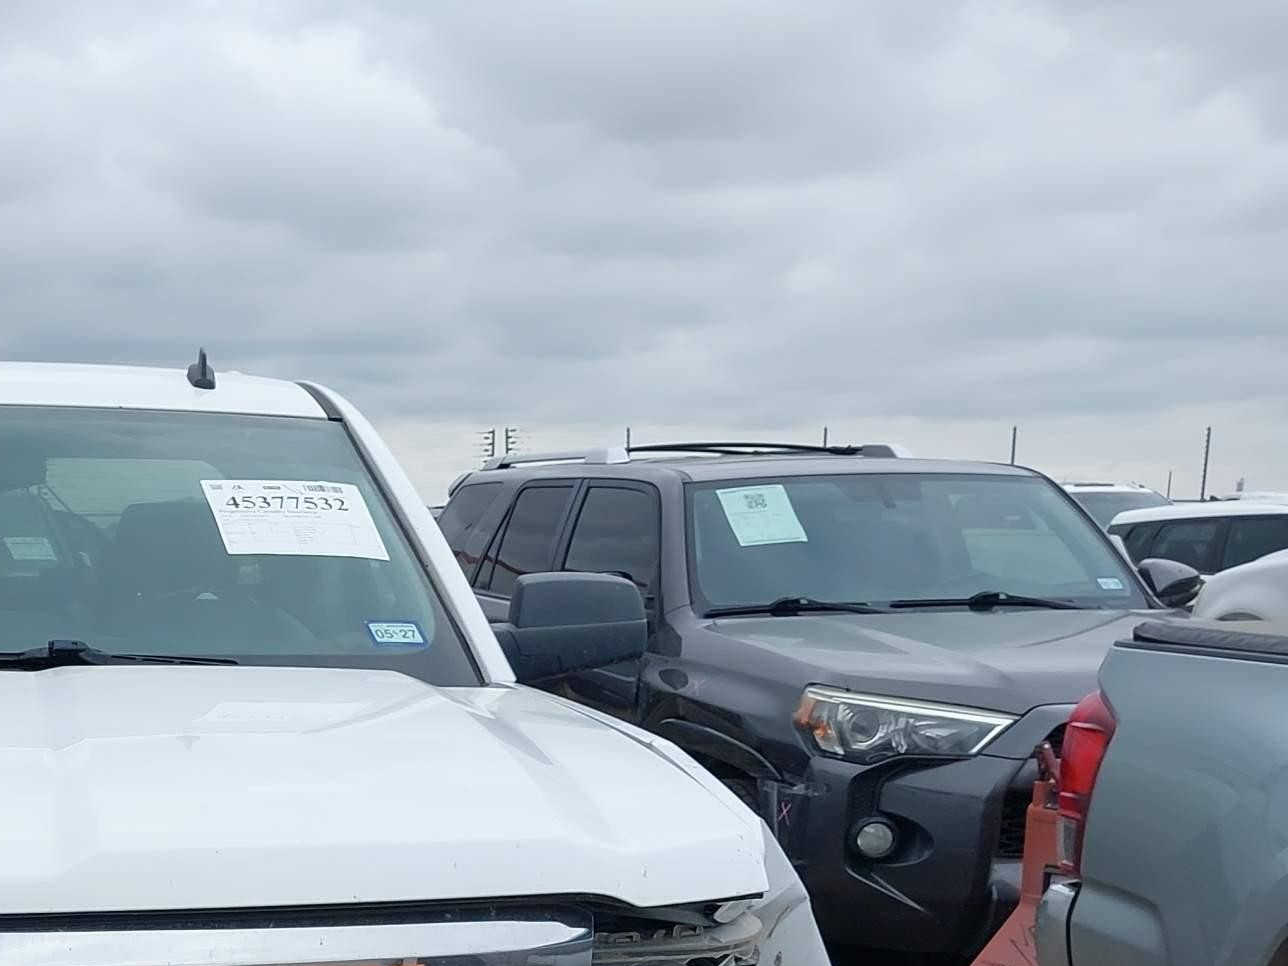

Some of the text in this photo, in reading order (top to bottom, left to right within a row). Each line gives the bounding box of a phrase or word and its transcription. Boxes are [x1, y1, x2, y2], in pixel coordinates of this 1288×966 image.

[226, 495, 349, 512] 45377532
[375, 629, 416, 639] 05 27
